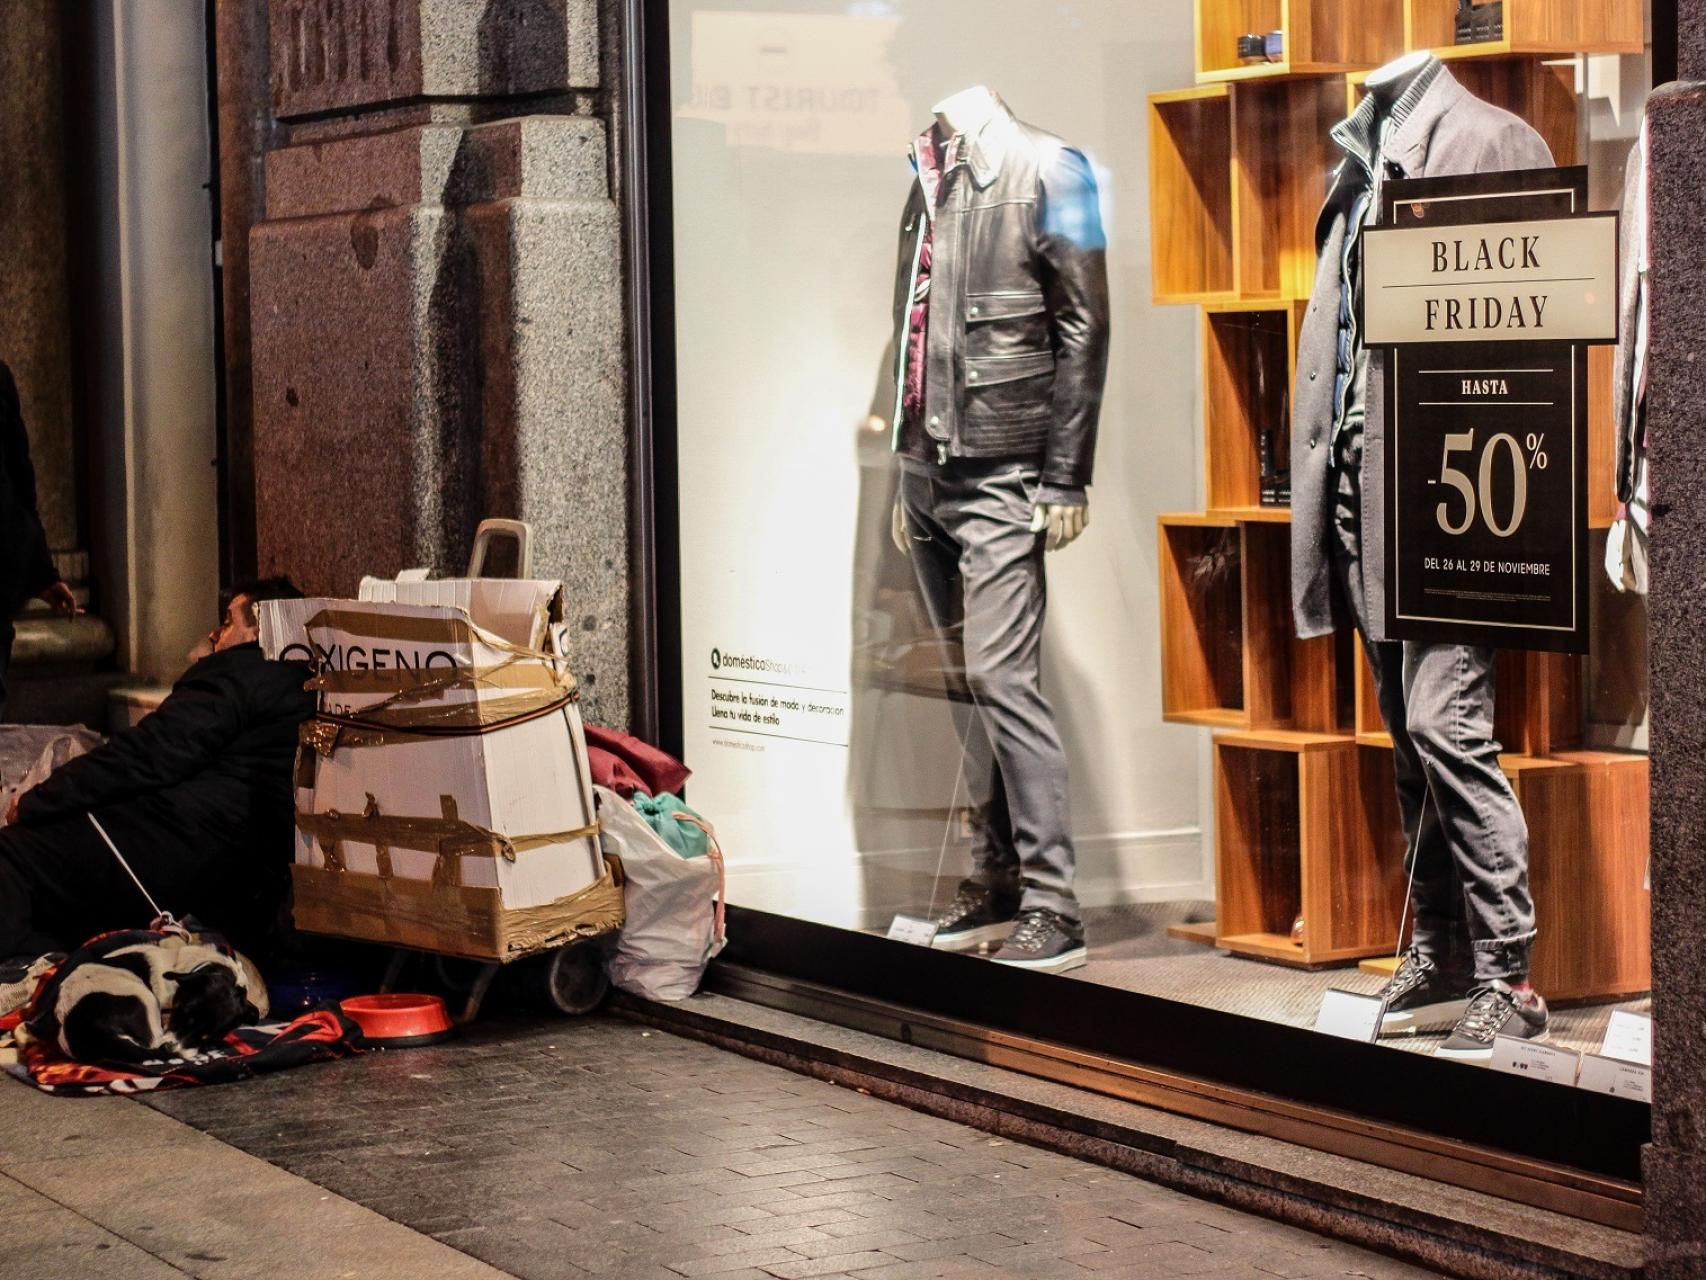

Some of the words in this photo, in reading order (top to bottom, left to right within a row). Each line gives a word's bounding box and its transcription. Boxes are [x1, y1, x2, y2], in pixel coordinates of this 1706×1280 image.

[1431, 235, 1541, 273] BLACK
[1424, 295, 1548, 331] FRIDAY
[1461, 379, 1509, 395] HASTA
[1424, 557, 1440, 570] DEL
[1443, 559, 1453, 570] 26
[1456, 559, 1467, 571] AL
[1470, 560, 1480, 572] 29
[1484, 561, 1495, 572] DE
[1498, 562, 1550, 575] NOVIEMBRE
[711, 689, 740, 703] Descubre
[741, 691, 748, 704] la
[770, 696, 779, 708] de
[729, 710, 736, 720] tu
[737, 710, 751, 722] vida
[752, 711, 761, 723] de
[763, 712, 780, 725] estilo
